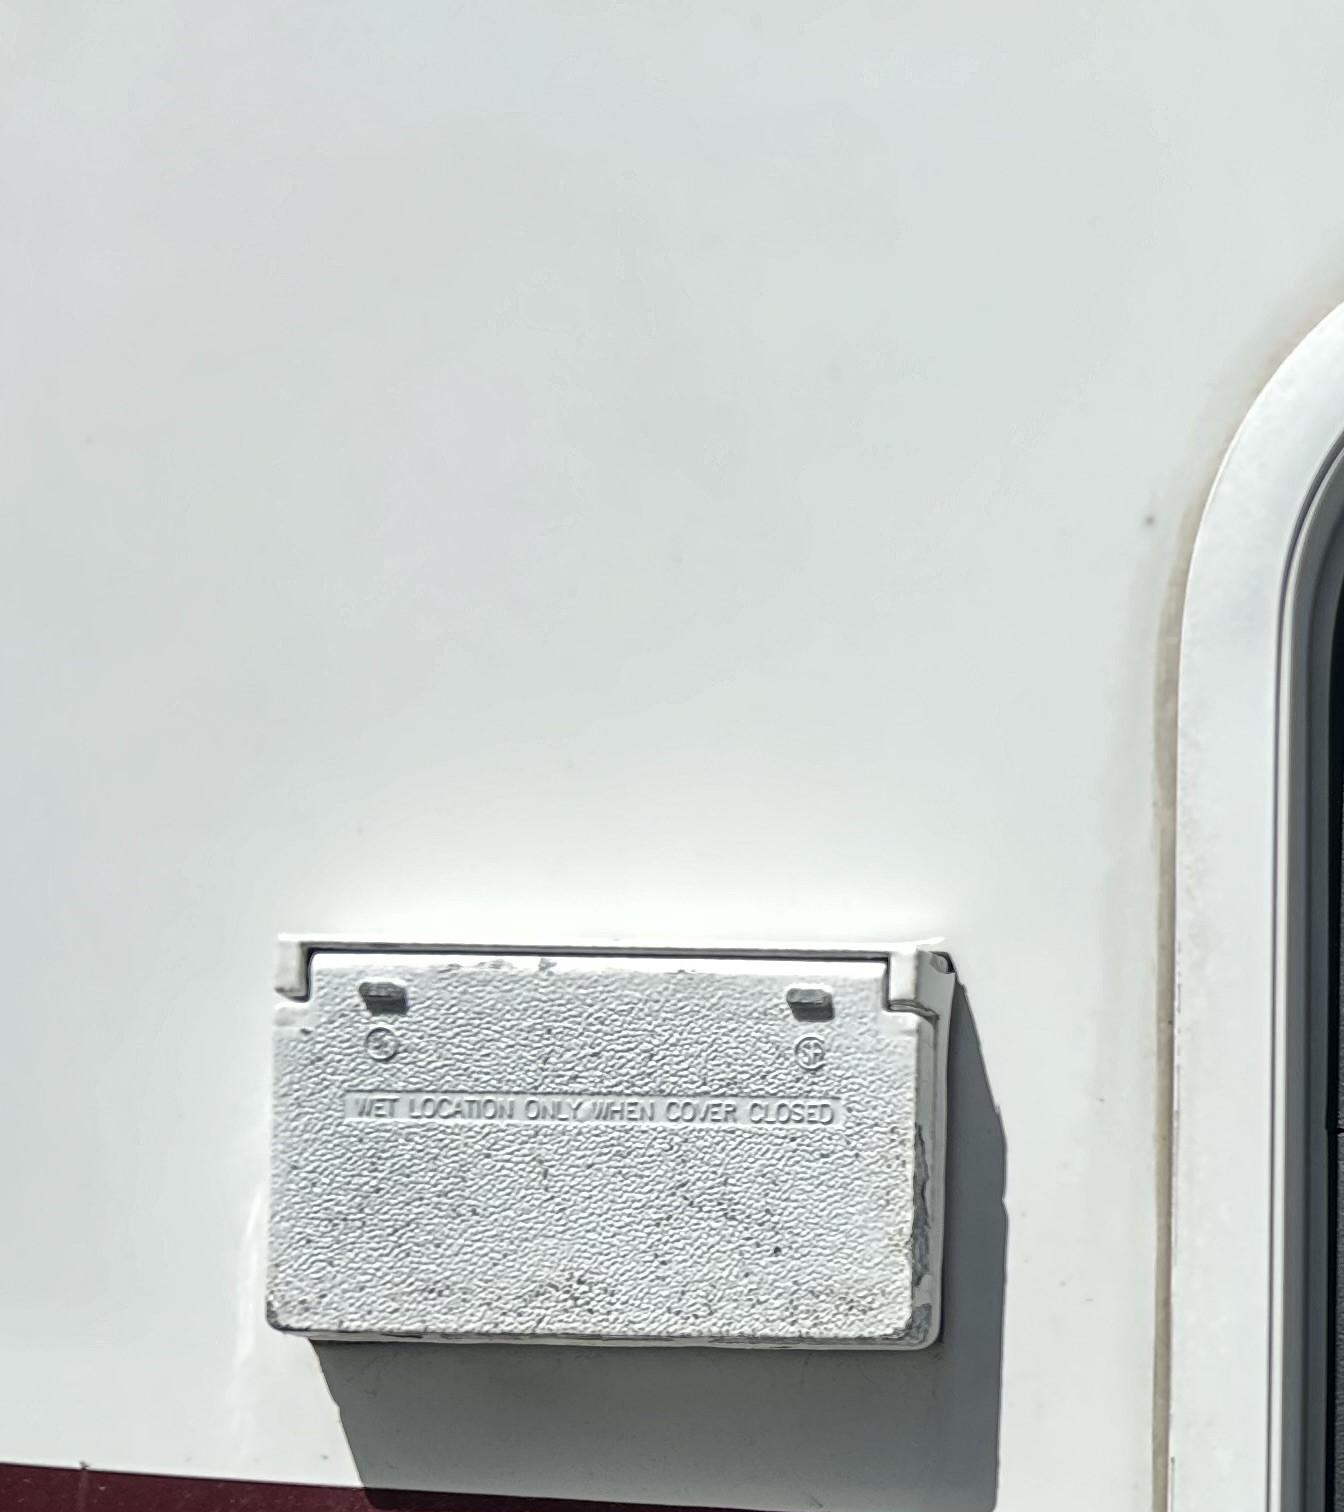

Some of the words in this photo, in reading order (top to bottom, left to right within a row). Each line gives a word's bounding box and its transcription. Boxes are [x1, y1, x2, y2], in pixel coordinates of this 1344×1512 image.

[353, 1098, 400, 1120] WET
[408, 1098, 516, 1122] LOCATION
[525, 1098, 585, 1122] ONLY
[590, 1100, 657, 1123] WHEN
[665, 1101, 738, 1124] COVER
[748, 1102, 836, 1125] CLOSED
